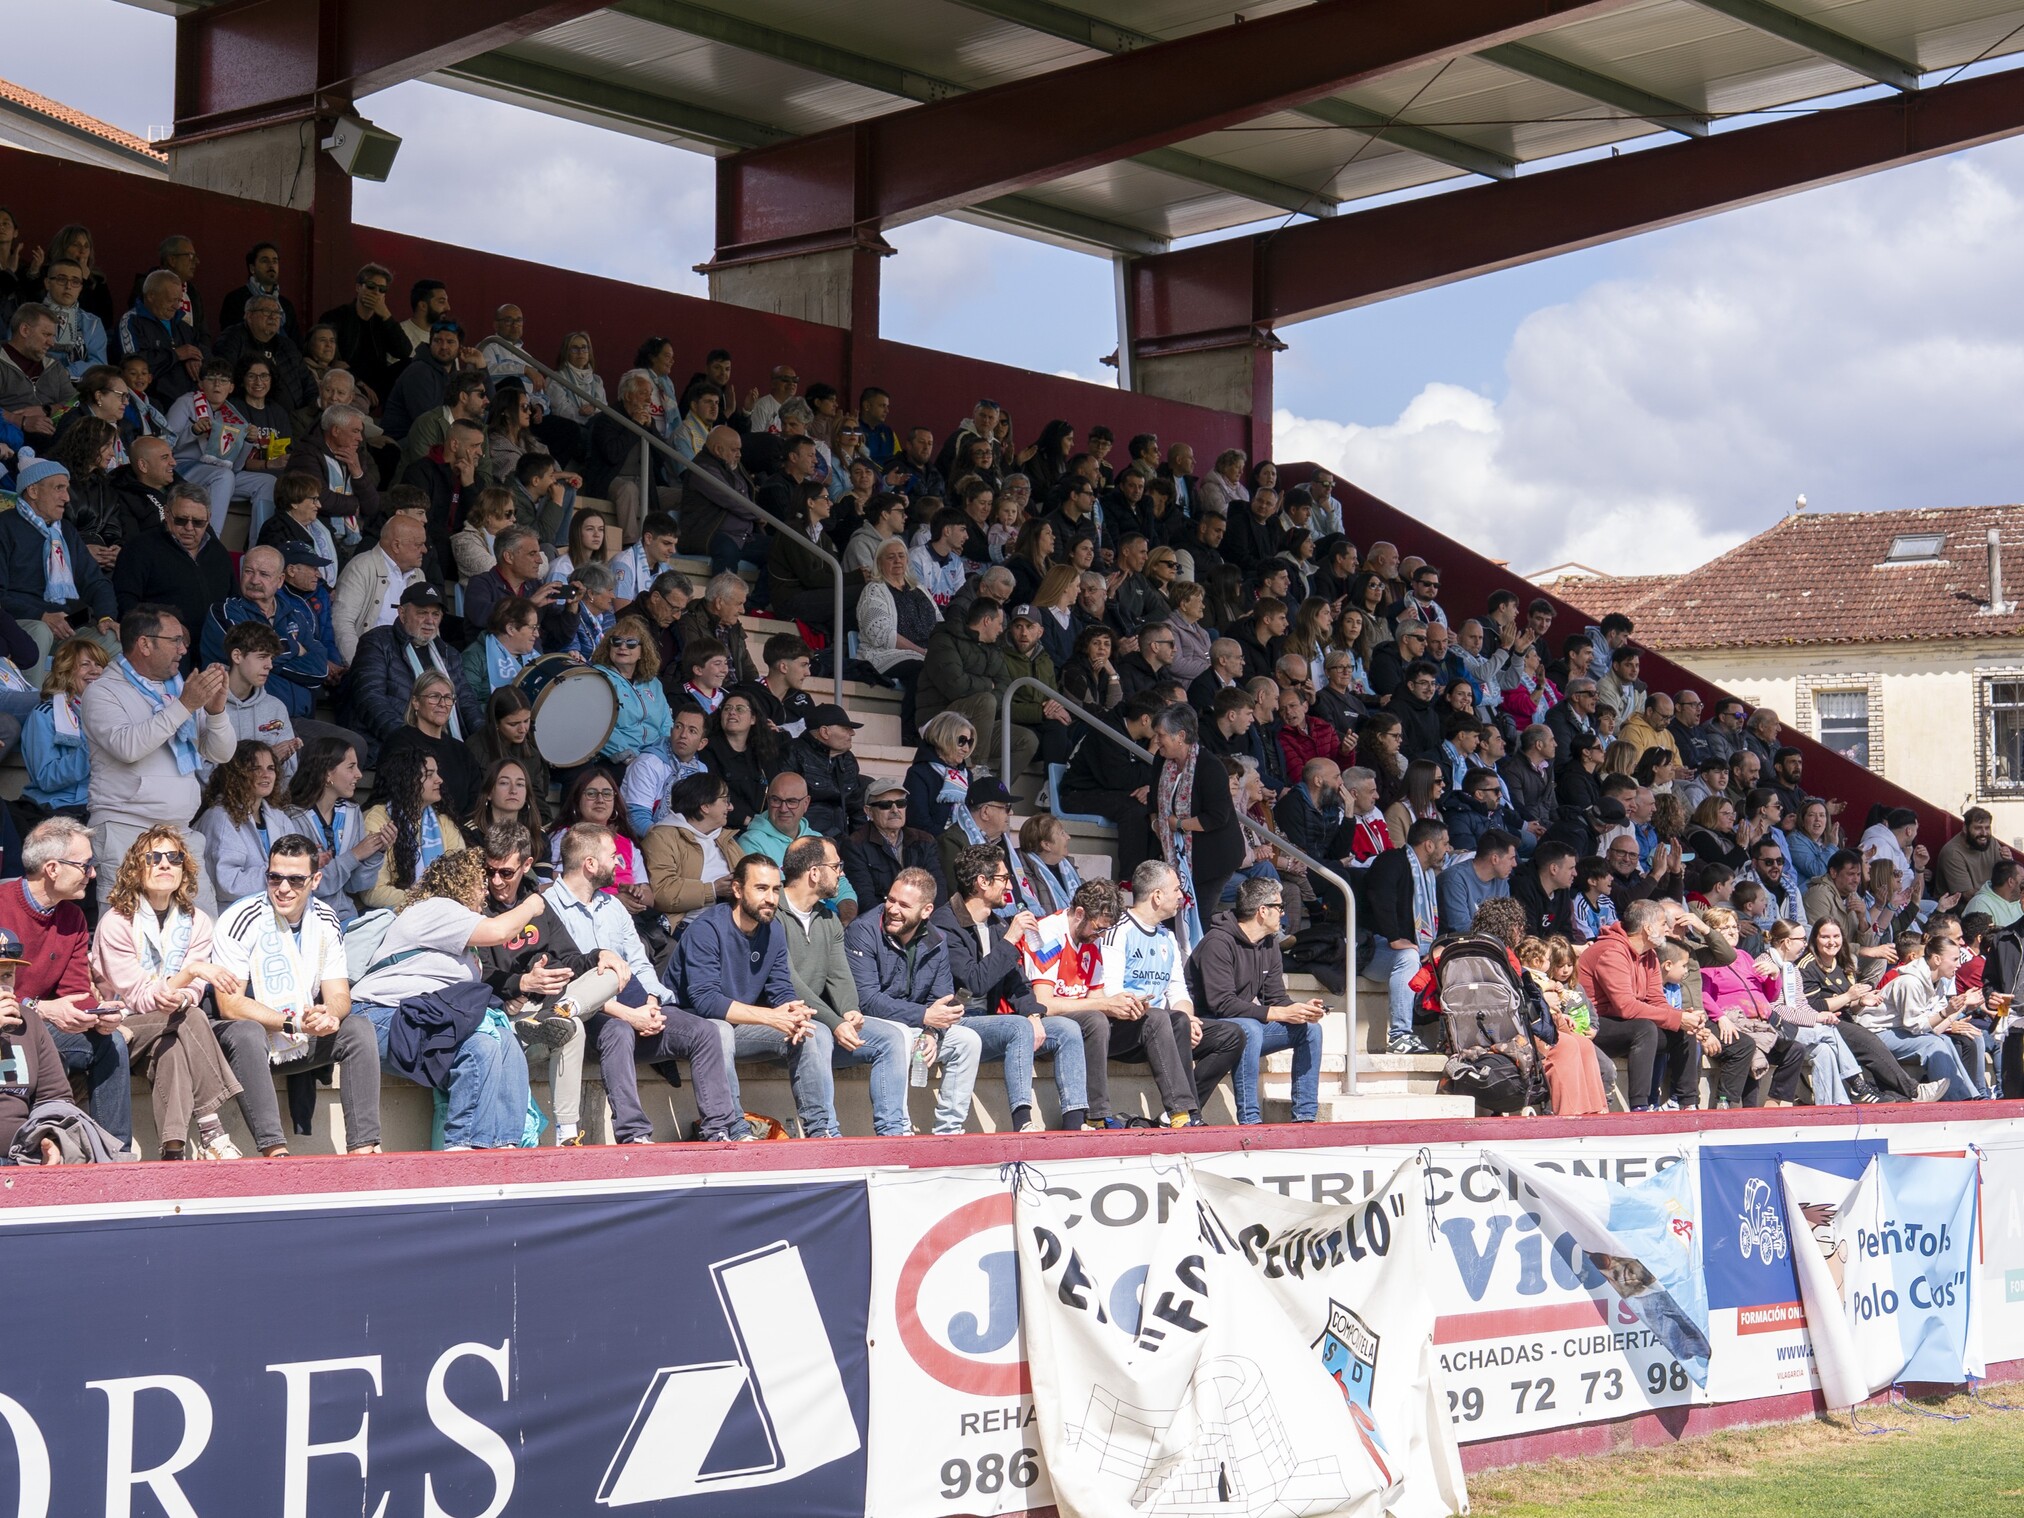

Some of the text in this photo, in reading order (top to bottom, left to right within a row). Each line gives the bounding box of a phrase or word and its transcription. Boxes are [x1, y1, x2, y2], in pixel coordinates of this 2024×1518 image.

[1132, 969, 1171, 982] SANTAGO
[1741, 1305, 1786, 1325] FORMACIÓN
[1332, 1311, 1374, 1360] COMPOTELA
[940, 1448, 1039, 1499] 986
[1511, 1377, 1556, 1414] 72
[1581, 1368, 1623, 1404] 73
[1648, 1360, 1688, 1395] 98
